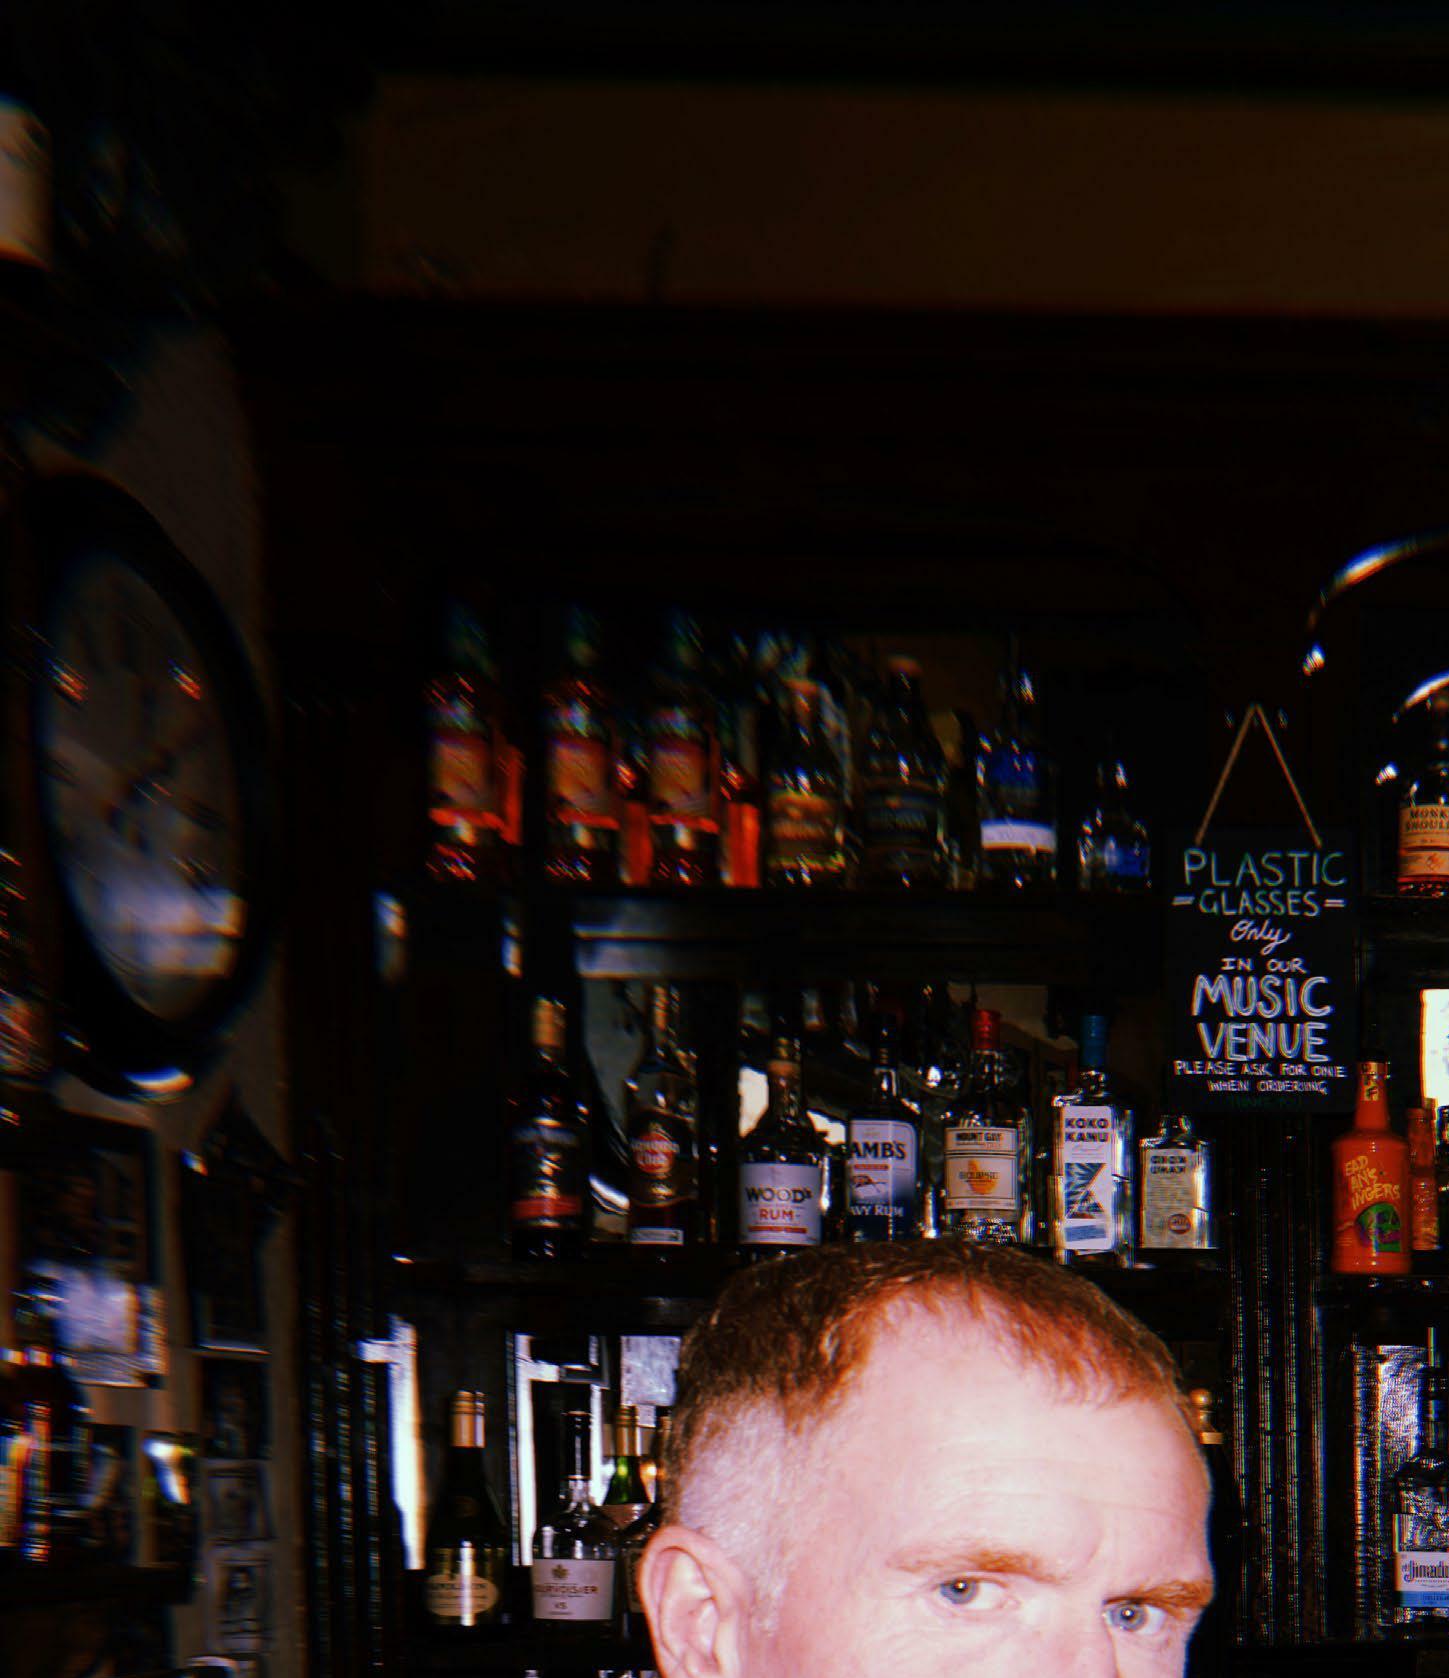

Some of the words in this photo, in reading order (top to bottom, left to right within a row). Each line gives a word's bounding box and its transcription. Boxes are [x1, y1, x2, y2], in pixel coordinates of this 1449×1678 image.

[1183, 848, 1348, 887] PLASTIC
[1198, 887, 1321, 917] GLASSES
[1229, 918, 1293, 956] Only
[1220, 956, 1253, 972] IN
[1266, 956, 1308, 975] OUR
[1191, 973, 1333, 1018] MUSIC
[1196, 1020, 1332, 1062] VENUE
[1173, 1059, 1236, 1077] PLEASE
[1240, 1062, 1273, 1078] ASK
[1279, 1062, 1308, 1077] FOR
[1310, 1064, 1348, 1078] ONE
[1064, 1116, 1110, 1129] KOKO
[1064, 1130, 1110, 1144] KANU
[1344, 1154, 1369, 1177] EAD
[1350, 1166, 1379, 1194] AN'S
[1351, 1182, 1401, 1211] INGERS
[759, 1208, 795, 1221] RUM
